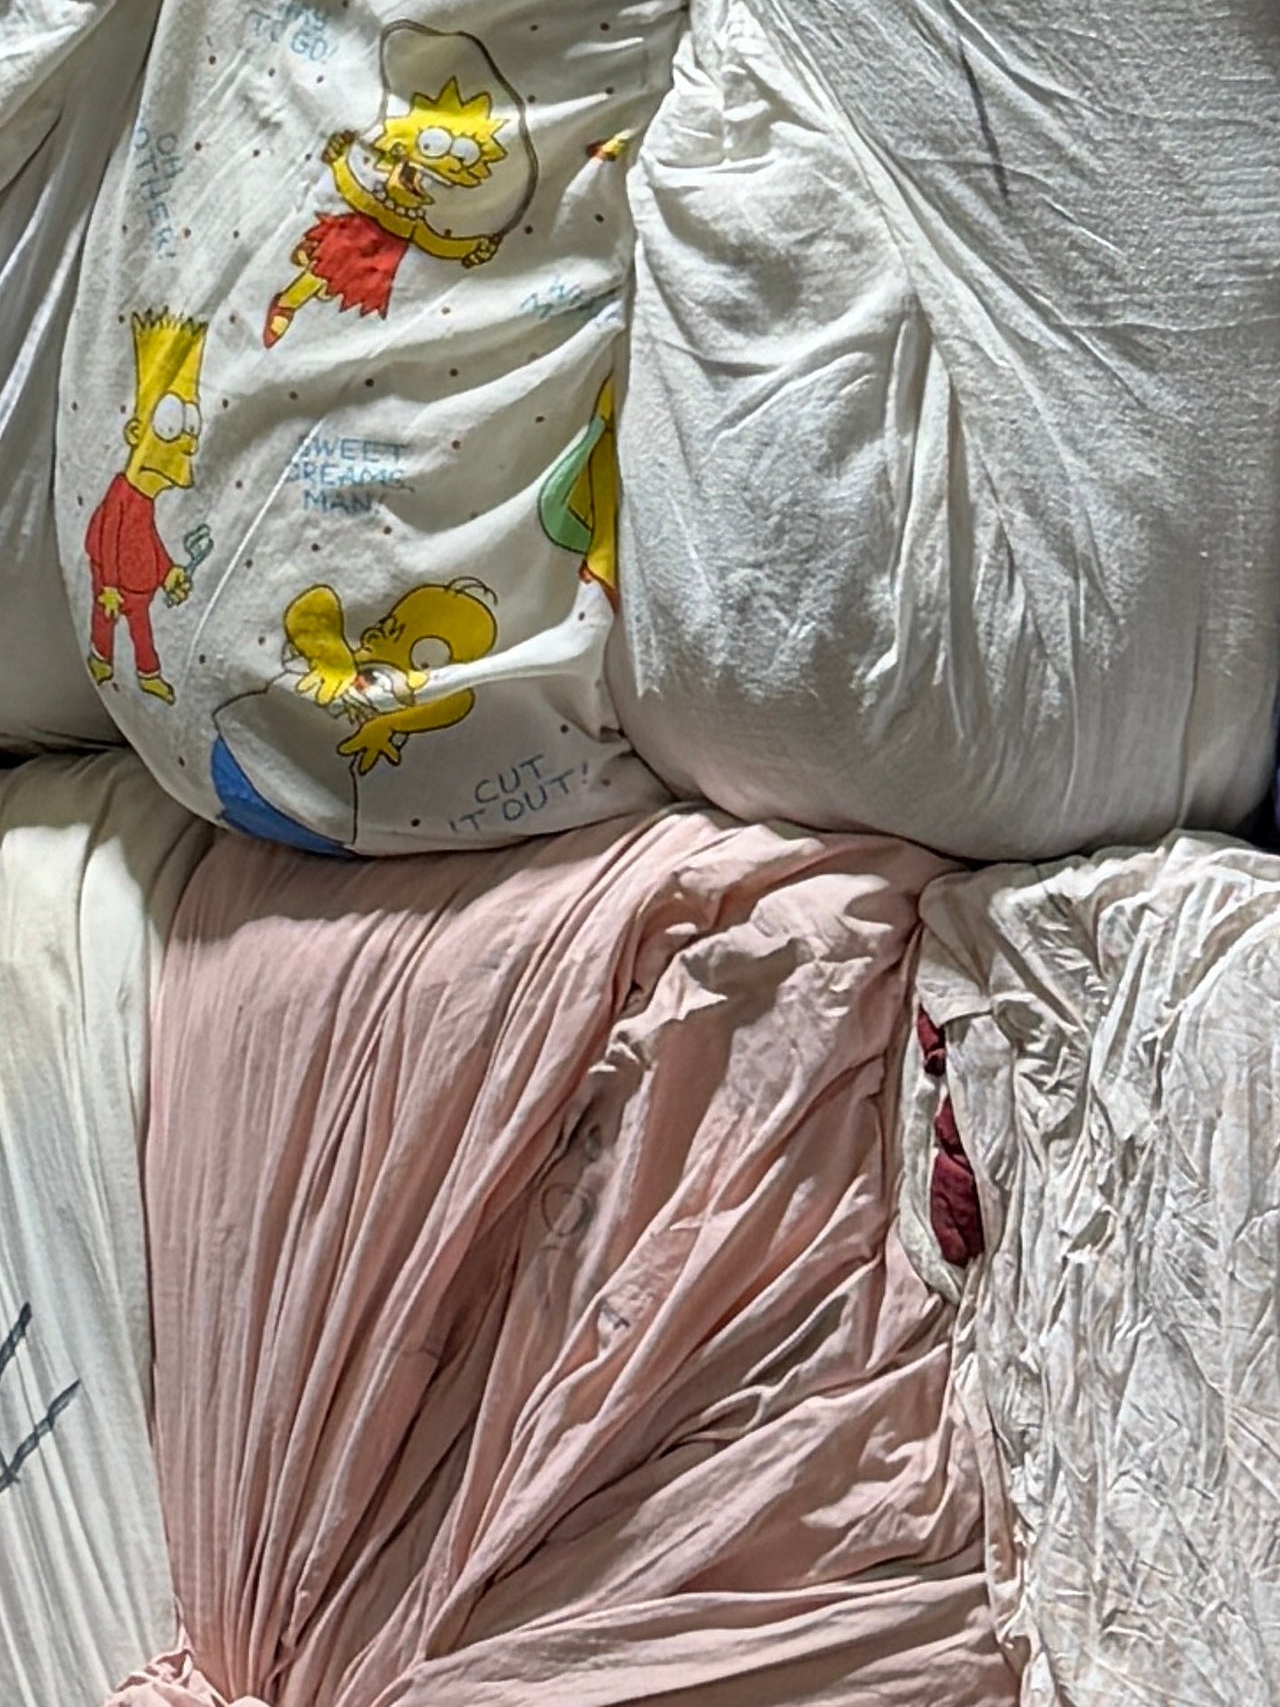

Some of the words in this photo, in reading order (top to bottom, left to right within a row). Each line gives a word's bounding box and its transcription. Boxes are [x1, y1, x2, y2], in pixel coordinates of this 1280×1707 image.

[156, 132, 185, 180] OH
[448, 807, 487, 833] IT
[502, 760, 589, 822] OUT!
[475, 753, 545, 804] CUT
